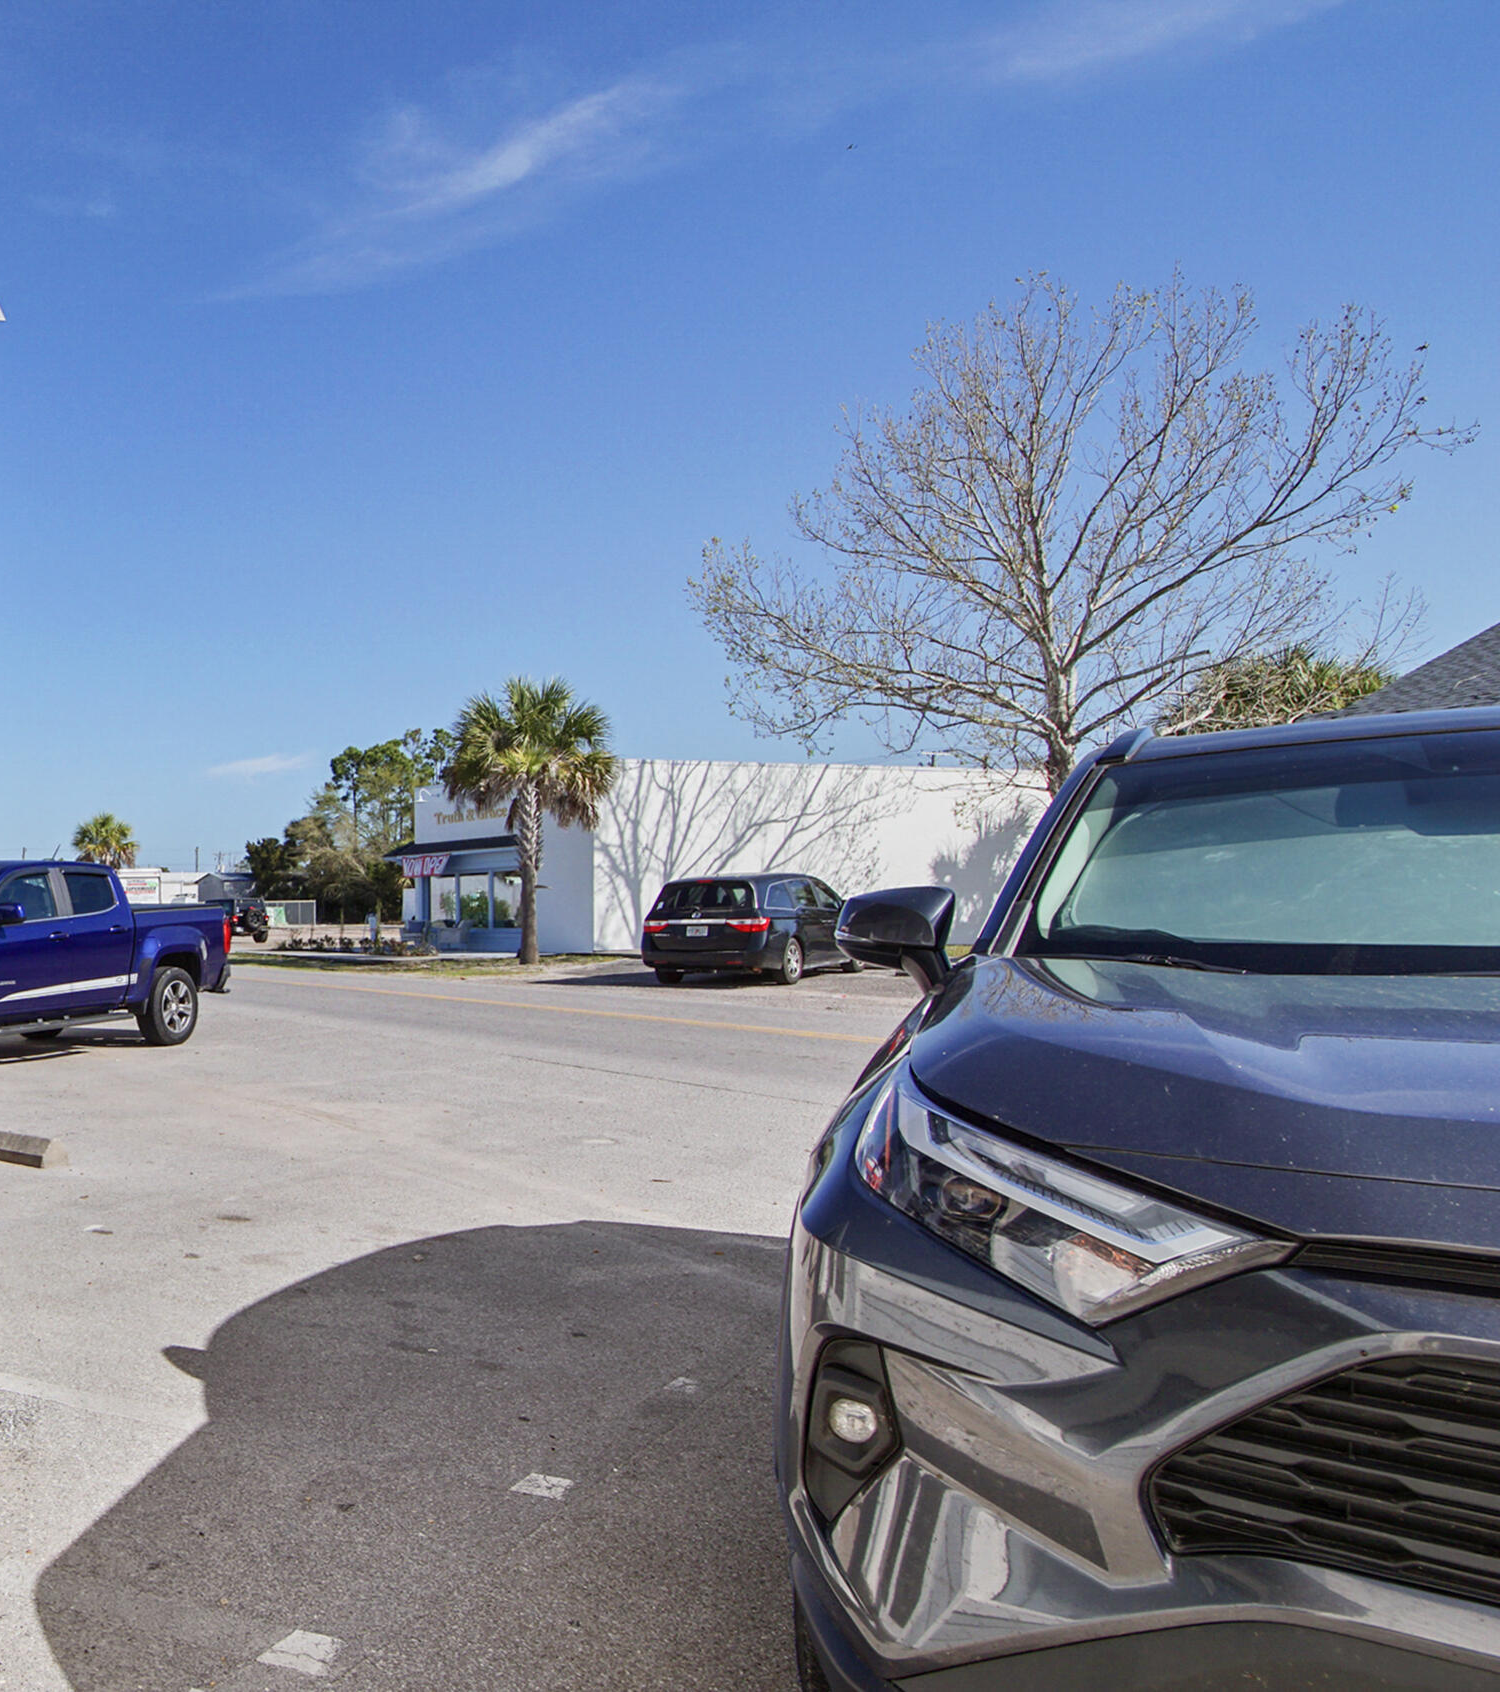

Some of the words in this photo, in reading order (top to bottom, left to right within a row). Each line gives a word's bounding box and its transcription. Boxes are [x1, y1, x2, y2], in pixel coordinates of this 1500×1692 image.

[434, 811, 464, 824] Truth
[466, 808, 476, 821] &
[403, 857, 421, 876] NOW
